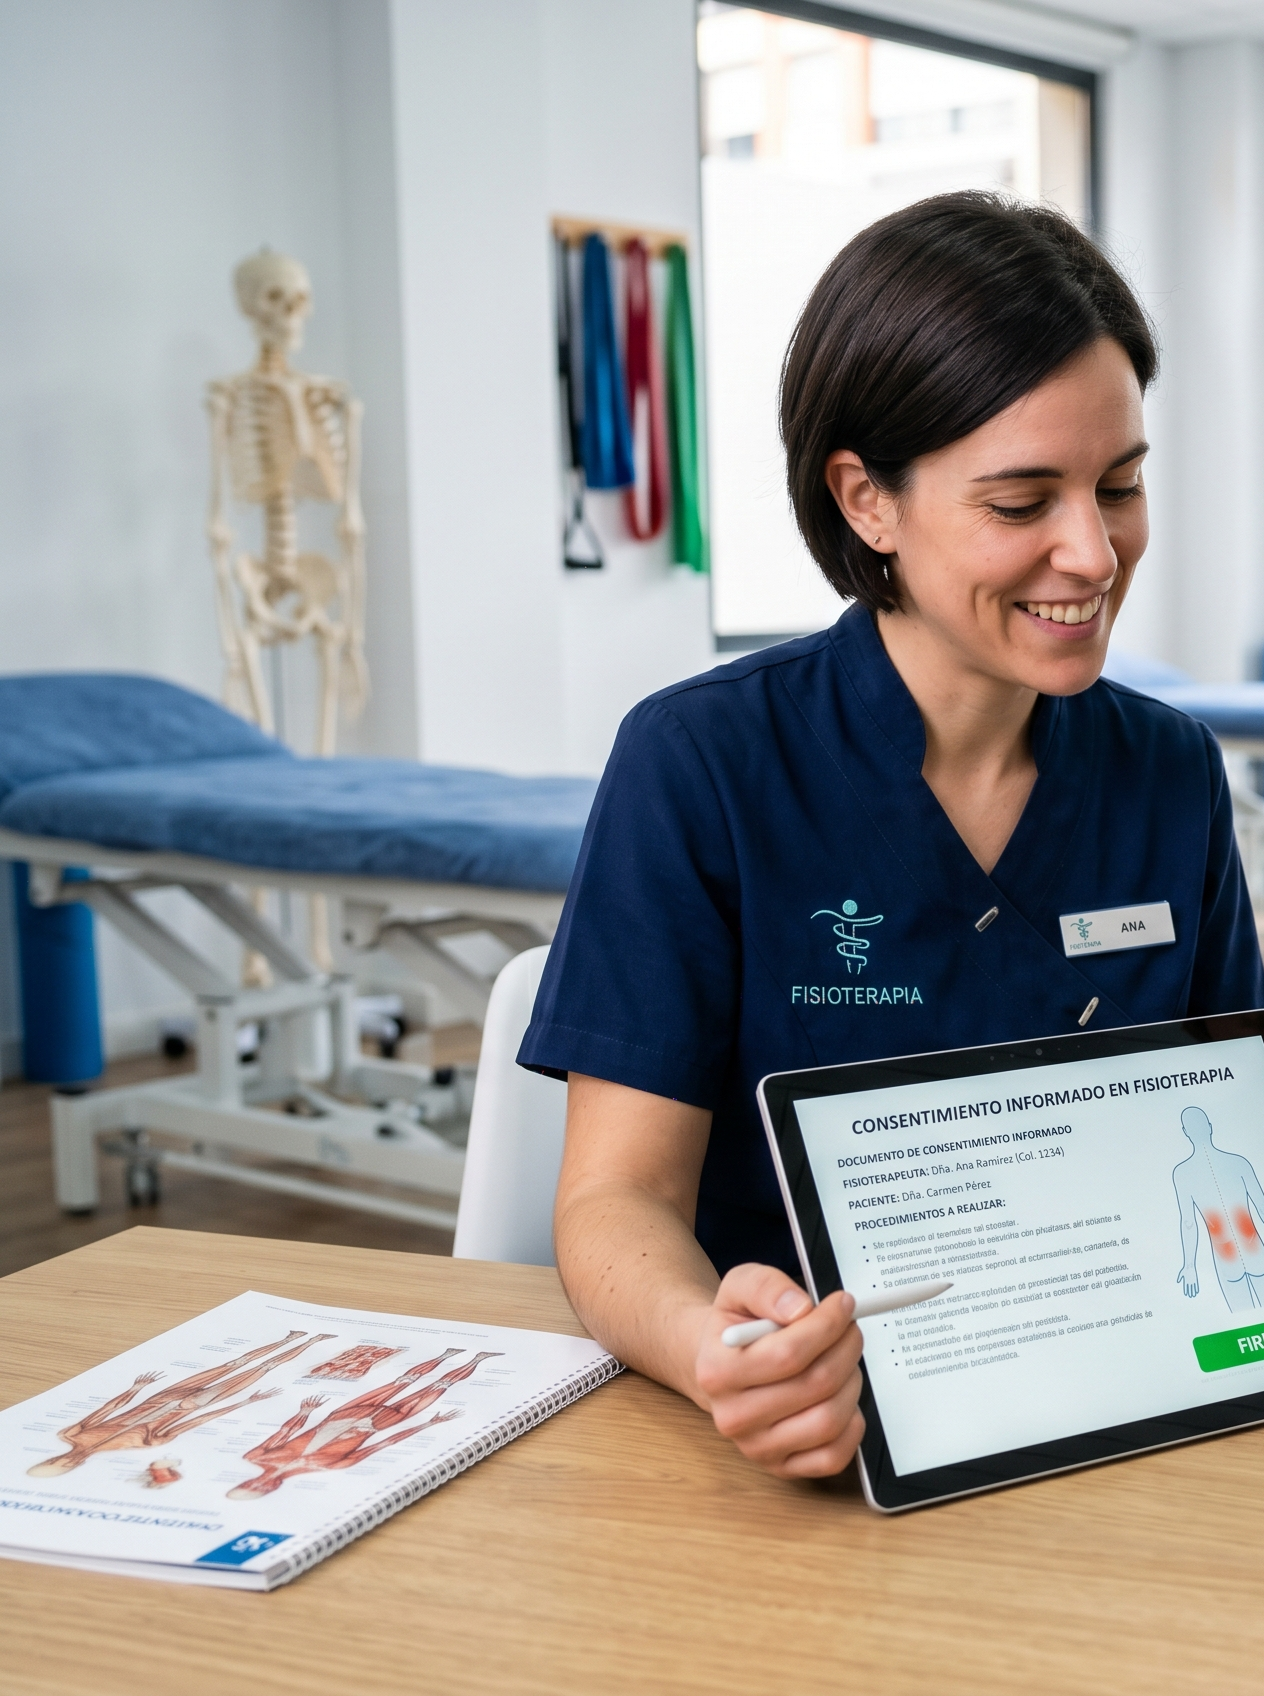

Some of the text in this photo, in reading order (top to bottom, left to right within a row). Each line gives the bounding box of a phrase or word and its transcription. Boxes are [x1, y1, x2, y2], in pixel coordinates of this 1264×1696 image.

[1121, 920, 1146, 933] ANA
[792, 986, 923, 1004] FISIOTERAPIA
[852, 1066, 1235, 1134] CONSENTIMIENTO INFORMADO EN FISIOTERAPIA
[837, 1124, 1072, 1168] DOCUMENTO DE CONSENTIMIENTO INFORMADO
[843, 1168, 930, 1189] FISIOTERAPEUTA:
[956, 1161, 974, 1172] Ana
[1015, 1150, 1037, 1164] (Col.
[1038, 1146, 1065, 1159] 1234)
[848, 1180, 992, 1210] PACIENTE: Dña. Carmen Pérez
[854, 1208, 945, 1231] PROCEDIMIENTOS
[947, 1206, 955, 1215] A
